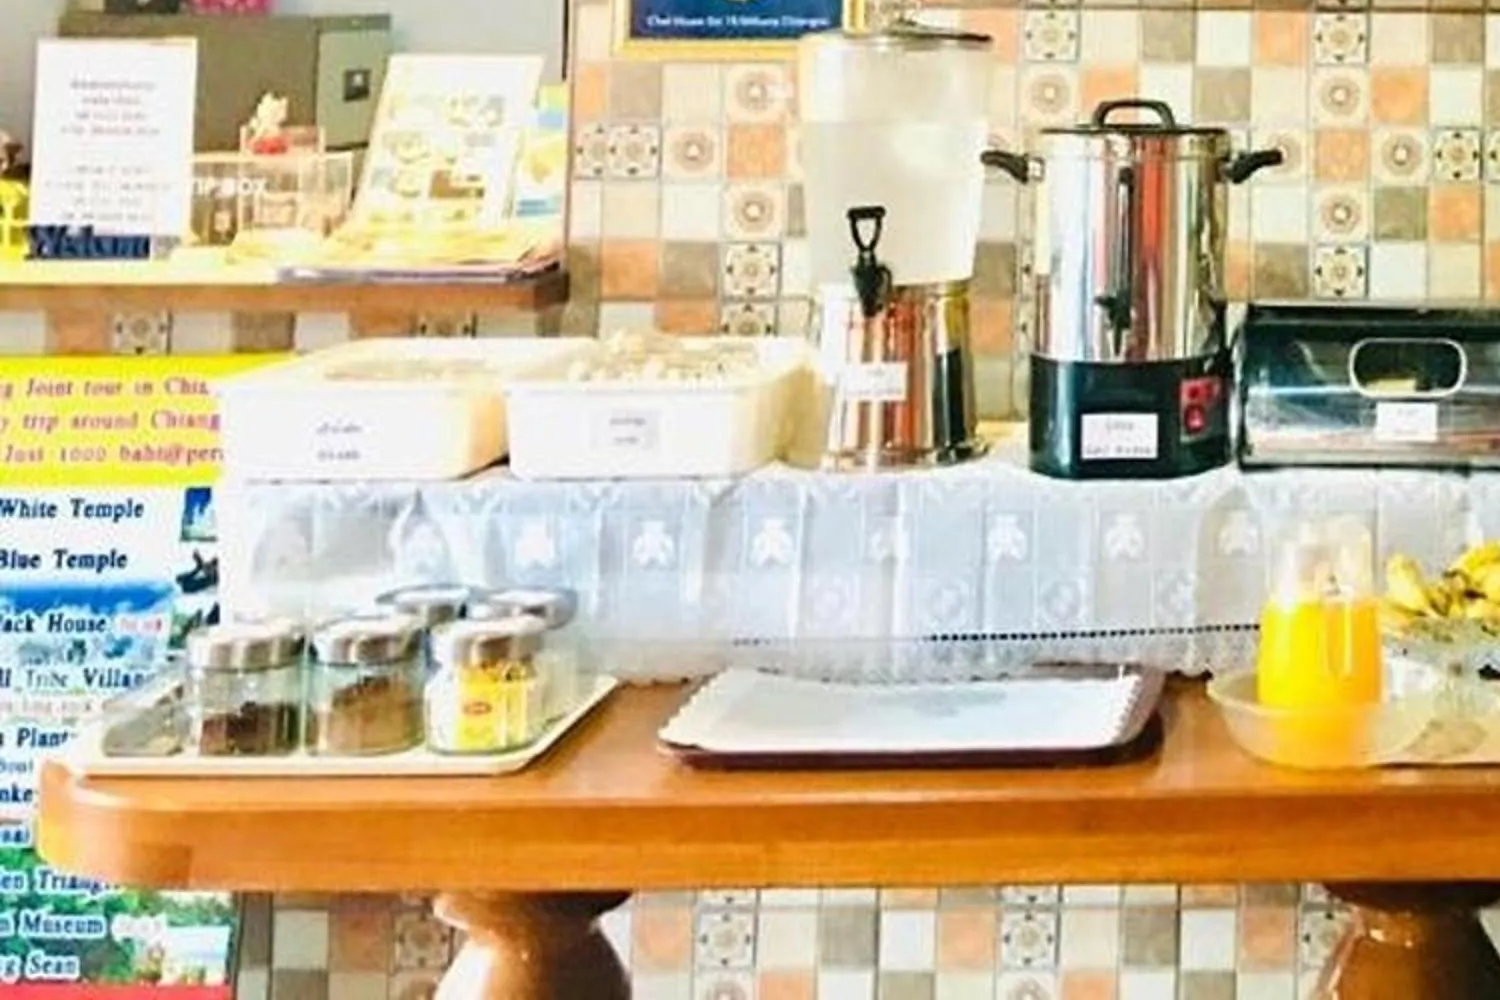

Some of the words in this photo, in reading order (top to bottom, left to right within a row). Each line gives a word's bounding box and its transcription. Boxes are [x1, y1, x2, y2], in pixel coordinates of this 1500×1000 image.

[26, 378, 73, 396] Joint
[84, 380, 123, 395] tour
[134, 380, 153, 396] in
[22, 414, 58, 434] trip
[71, 411, 138, 429] around
[151, 411, 221, 431] Chiang
[5, 444, 44, 463] Just
[60, 446, 107, 462] 1000
[0, 498, 57, 518] White
[70, 497, 144, 523] Temple
[53, 549, 128, 573] Temple
[48, 612, 106, 632] House
[23, 911, 103, 934] Museum
[30, 954, 76, 975] Sean
